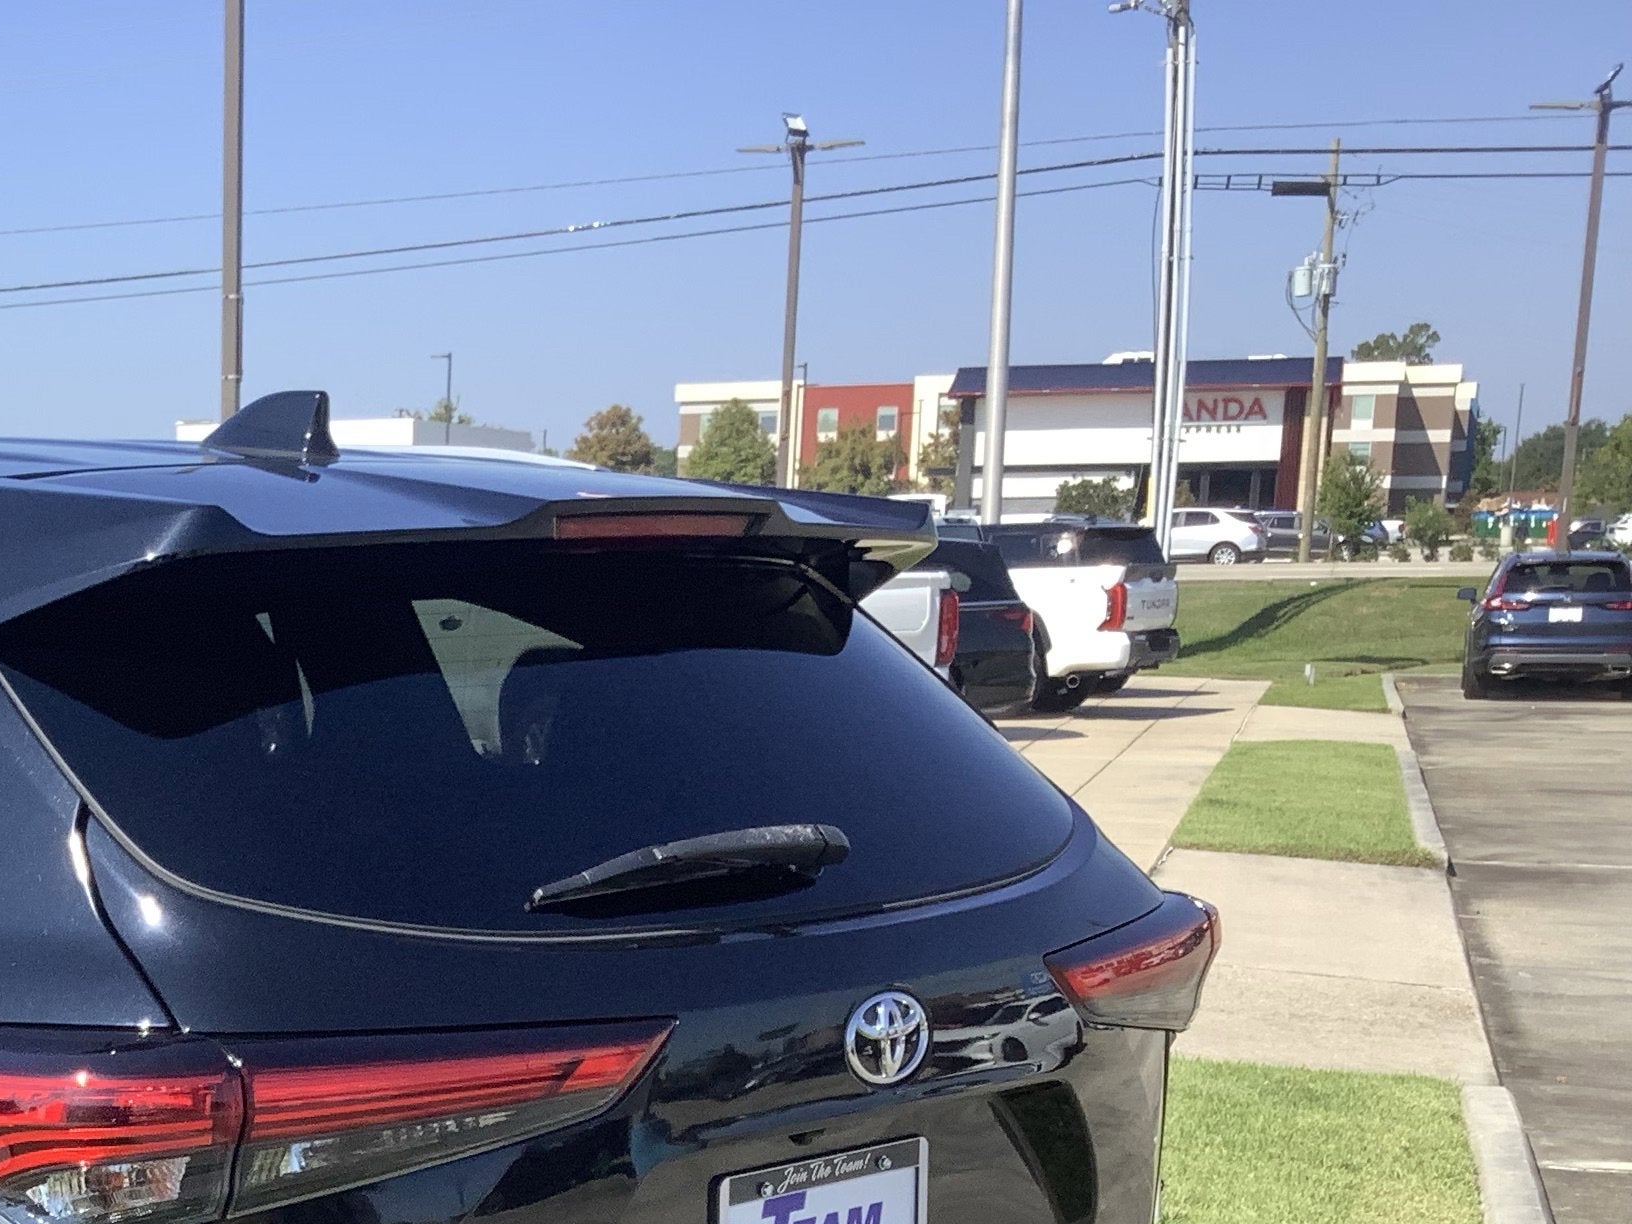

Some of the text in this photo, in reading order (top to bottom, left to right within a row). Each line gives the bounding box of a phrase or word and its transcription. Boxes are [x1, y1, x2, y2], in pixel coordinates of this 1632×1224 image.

[777, 1152, 872, 1194] Join The Team!
